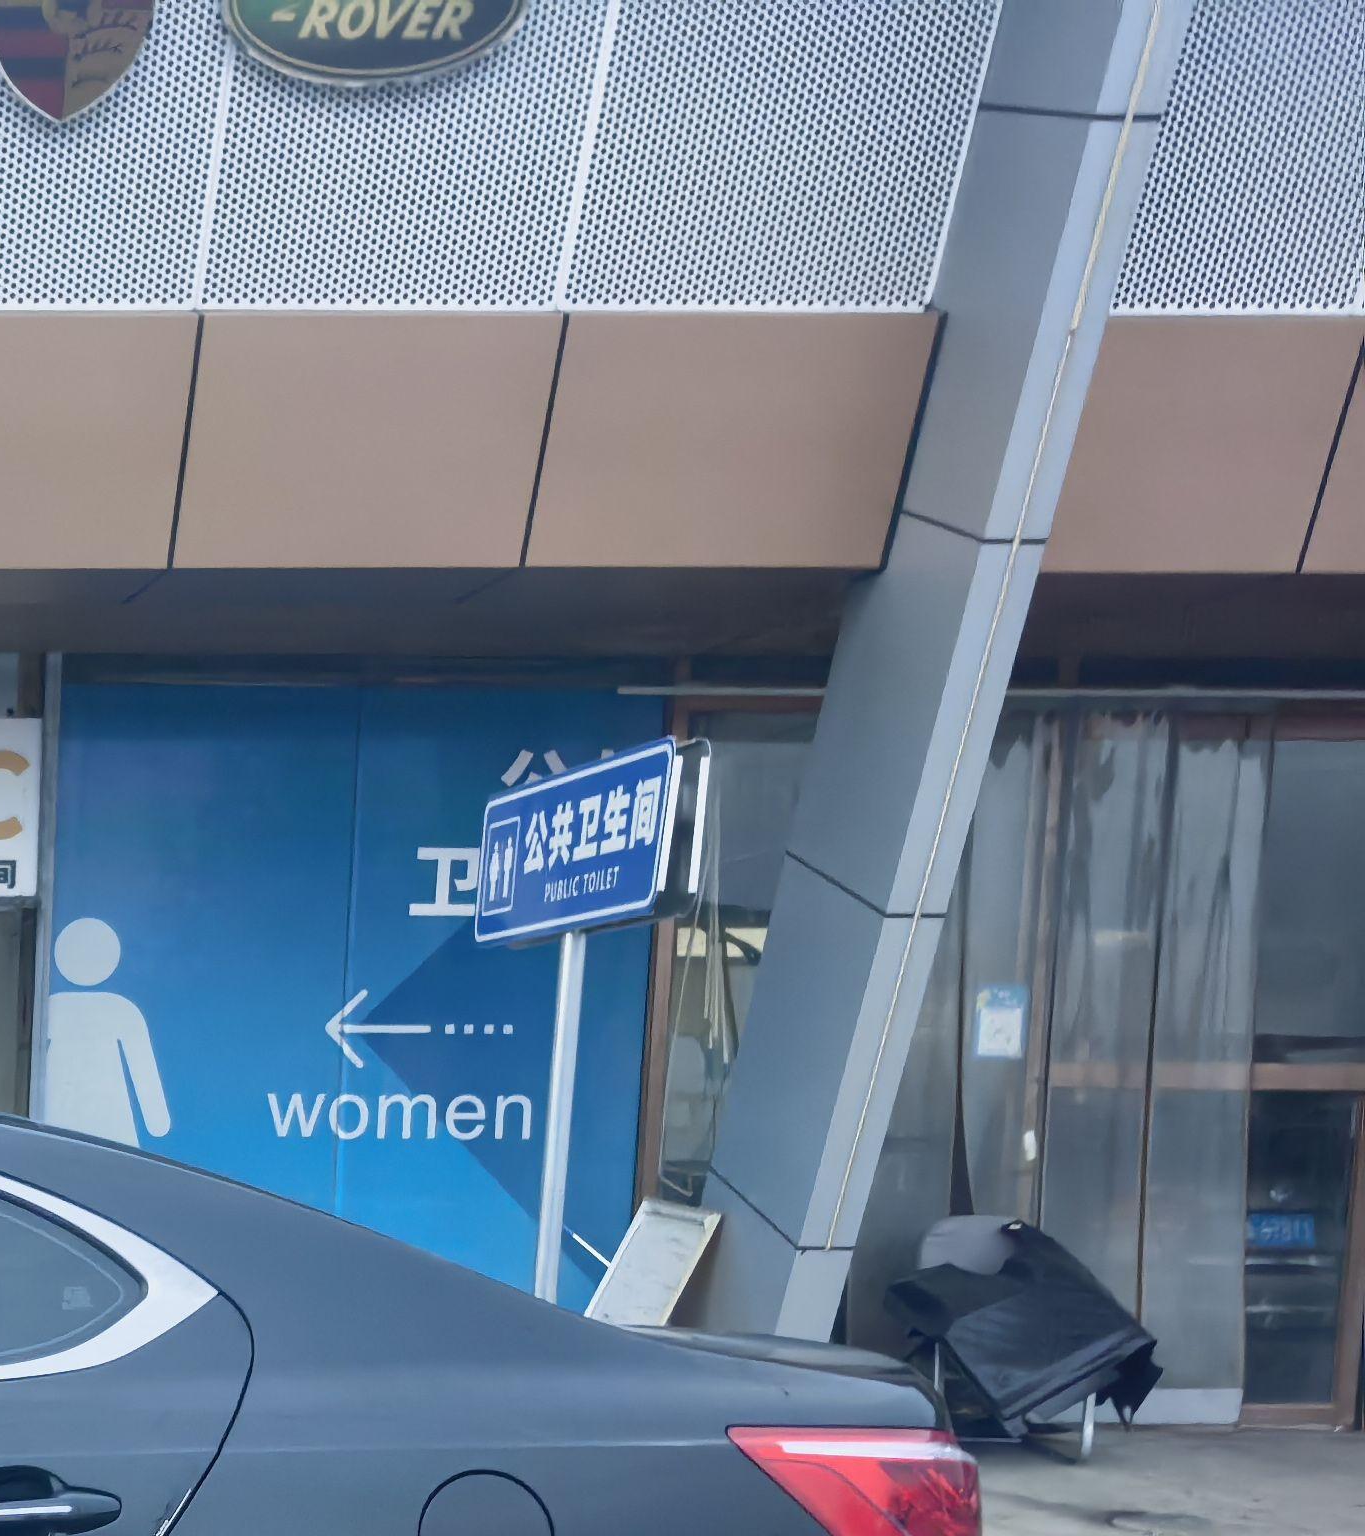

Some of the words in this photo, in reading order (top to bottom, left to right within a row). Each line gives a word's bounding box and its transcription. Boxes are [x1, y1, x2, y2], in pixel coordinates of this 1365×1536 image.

[523, 776, 663, 875] 公共卫生间
[544, 873, 579, 902] PUBLIC
[583, 866, 620, 894] TOILET
[267, 1093, 532, 1141] women
